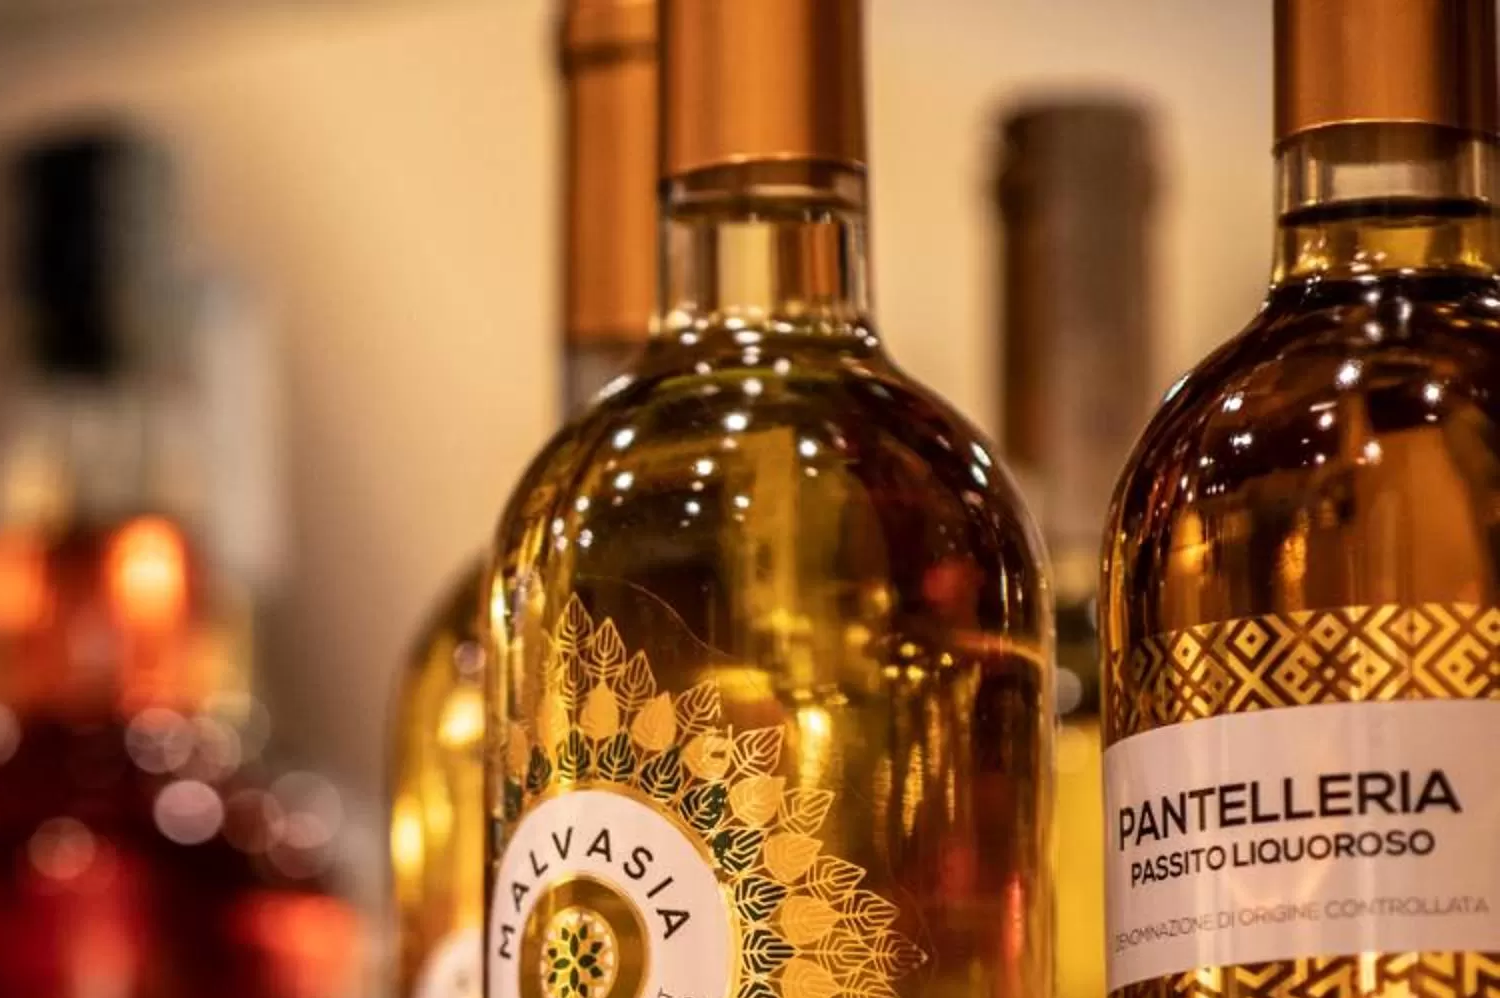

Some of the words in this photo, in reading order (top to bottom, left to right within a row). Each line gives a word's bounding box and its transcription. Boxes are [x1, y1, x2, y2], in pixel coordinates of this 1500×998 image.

[1118, 768, 1463, 851] PANTELLERIA
[499, 826, 691, 960] MALVASIA
[1131, 845, 1227, 888] PASSITO
[1232, 829, 1436, 869] LIQUOROSO
